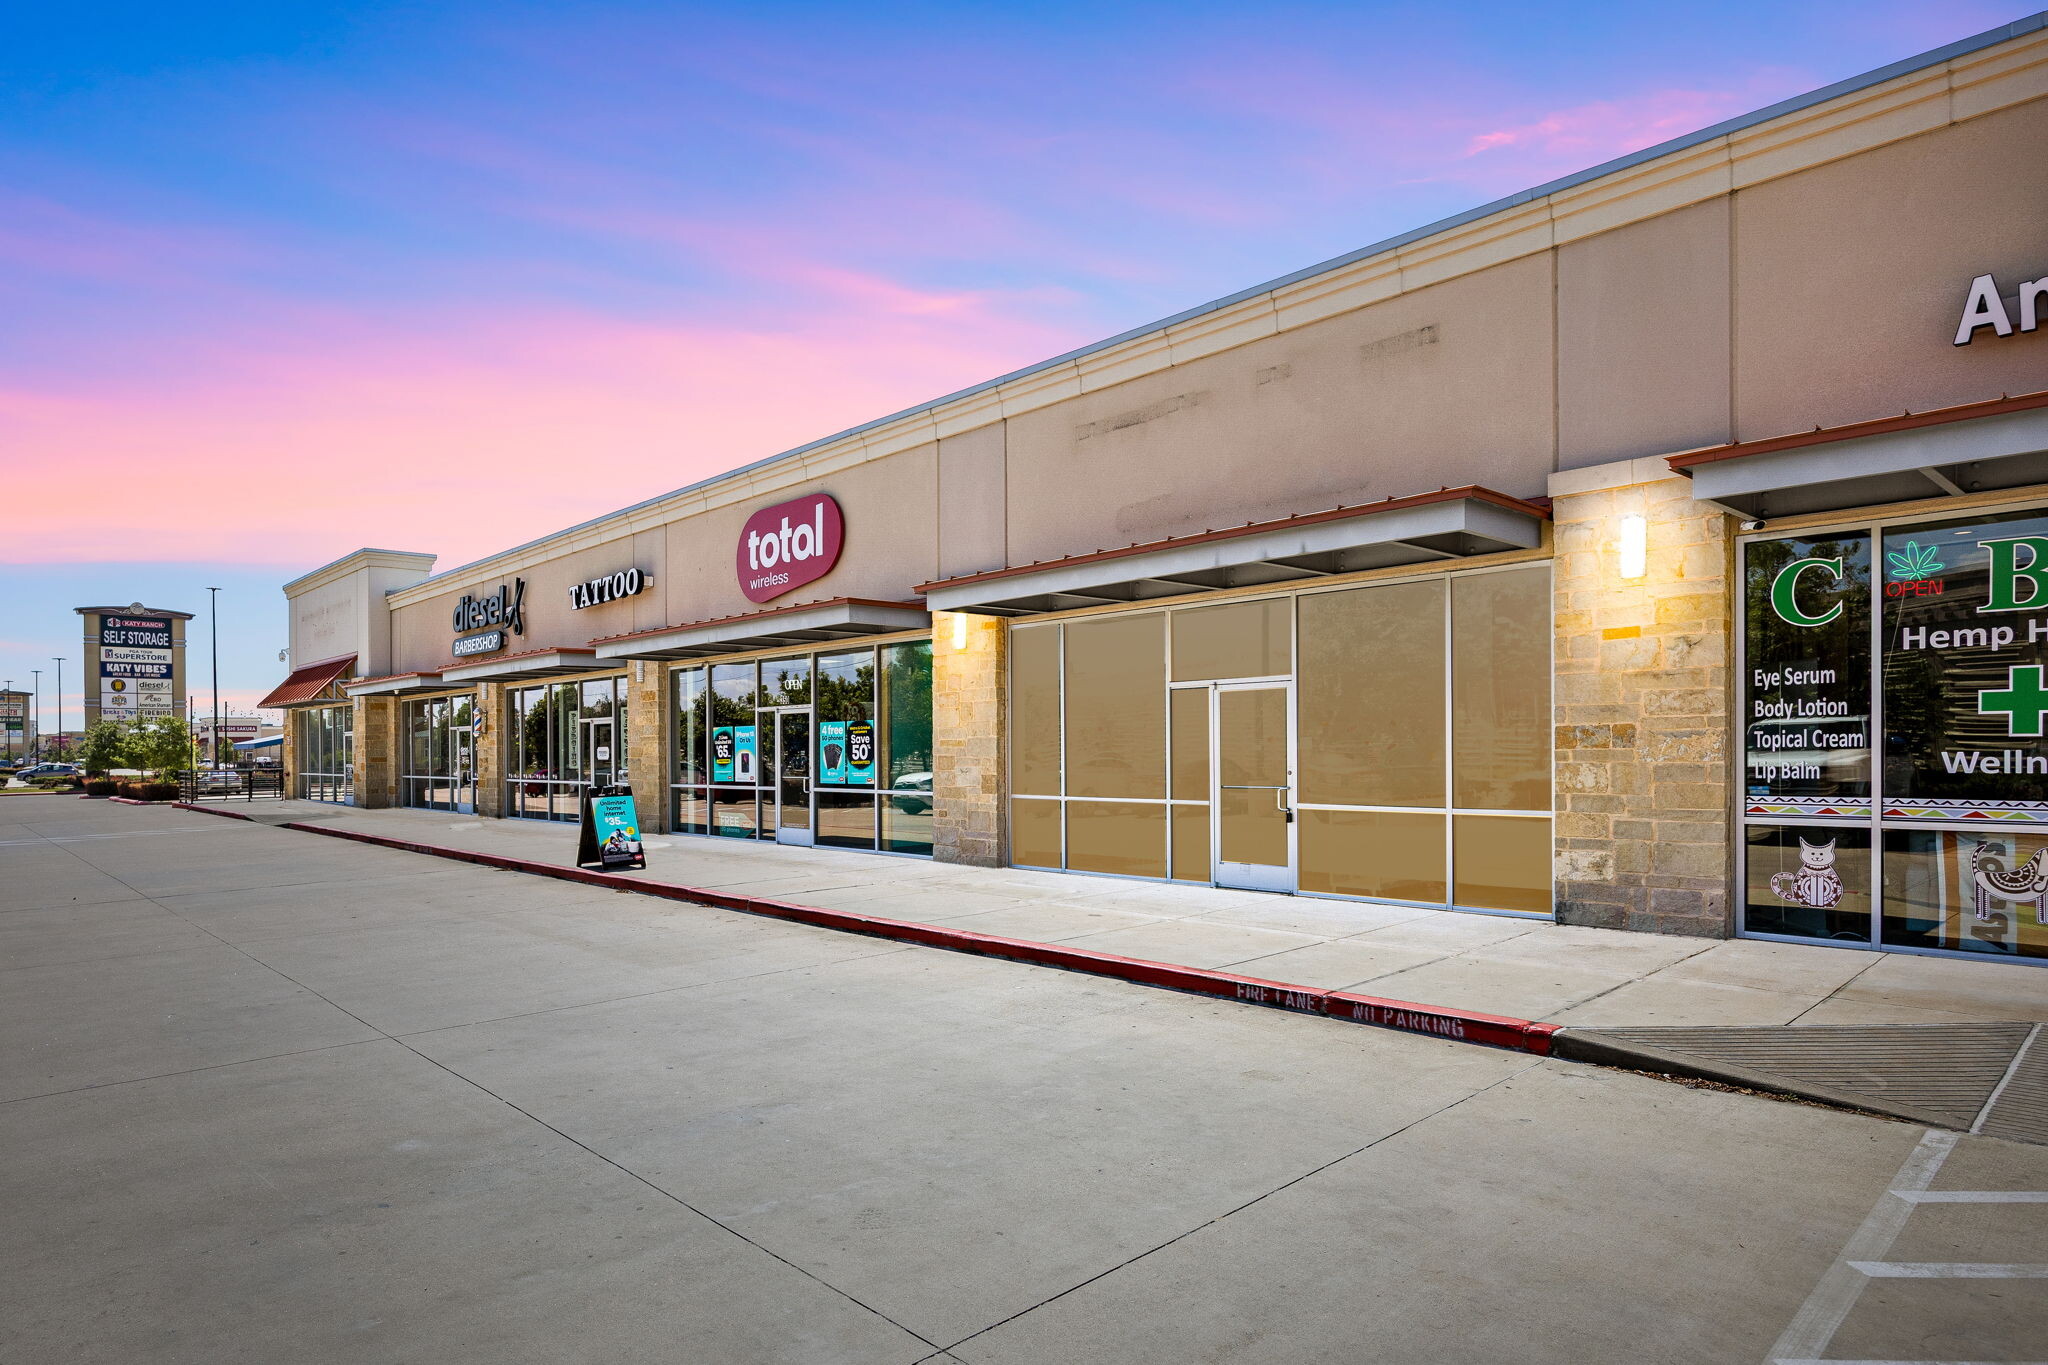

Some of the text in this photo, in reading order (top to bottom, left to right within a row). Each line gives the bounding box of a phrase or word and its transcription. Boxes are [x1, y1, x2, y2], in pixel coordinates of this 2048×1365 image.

[748, 502, 823, 570] total
[569, 568, 639, 610] TATTOO
[750, 572, 789, 589] wireless
[1886, 580, 1943, 597] OPEN
[1771, 556, 1843, 627] C
[453, 585, 506, 632] diesel
[104, 630, 169, 646] SELF STORAGE
[455, 635, 498, 655] BARBERSHOP
[1903, 624, 2014, 651] Hemp
[114, 653, 167, 661] SUPERSTORE
[106, 663, 167, 674] KATY VIBES
[1754, 667, 1836, 690] Eye Serum
[139, 681, 163, 689] diesel
[784, 679, 802, 690] OPEN
[1754, 697, 1848, 719] Body Lotion
[822, 724, 843, 735] 4 free
[851, 734, 870, 744] Save
[1754, 729, 1864, 752] Topical Cream
[1755, 761, 1820, 783] Lip Balm
[1942, 750, 2048, 774] Welln
[605, 817, 620, 826] $35
[1352, 1002, 1464, 1038] NO PARKING
